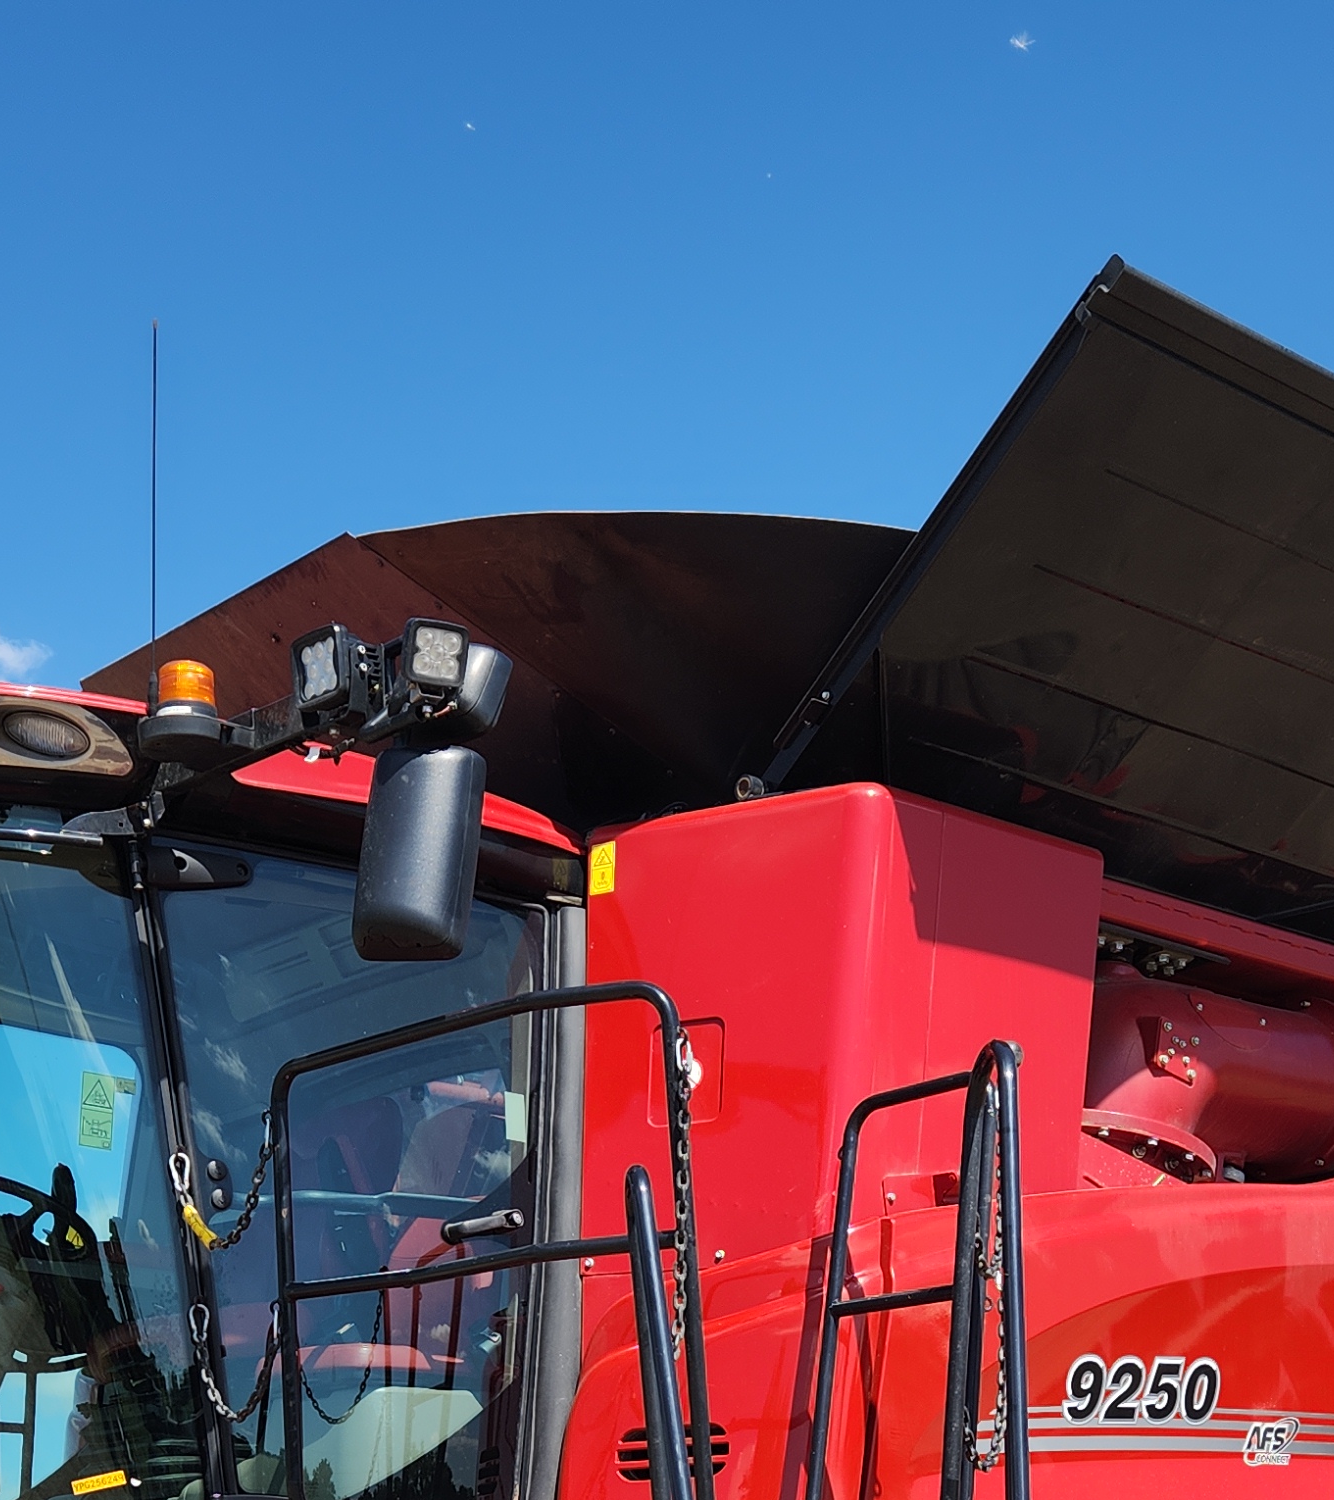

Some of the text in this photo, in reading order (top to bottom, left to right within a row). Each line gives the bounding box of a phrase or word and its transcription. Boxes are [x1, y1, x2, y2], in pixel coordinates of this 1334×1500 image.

[1063, 1355, 1220, 1424] 9250
[1245, 1422, 1289, 1451] AFS
[1254, 1452, 1290, 1466] CONNECT
